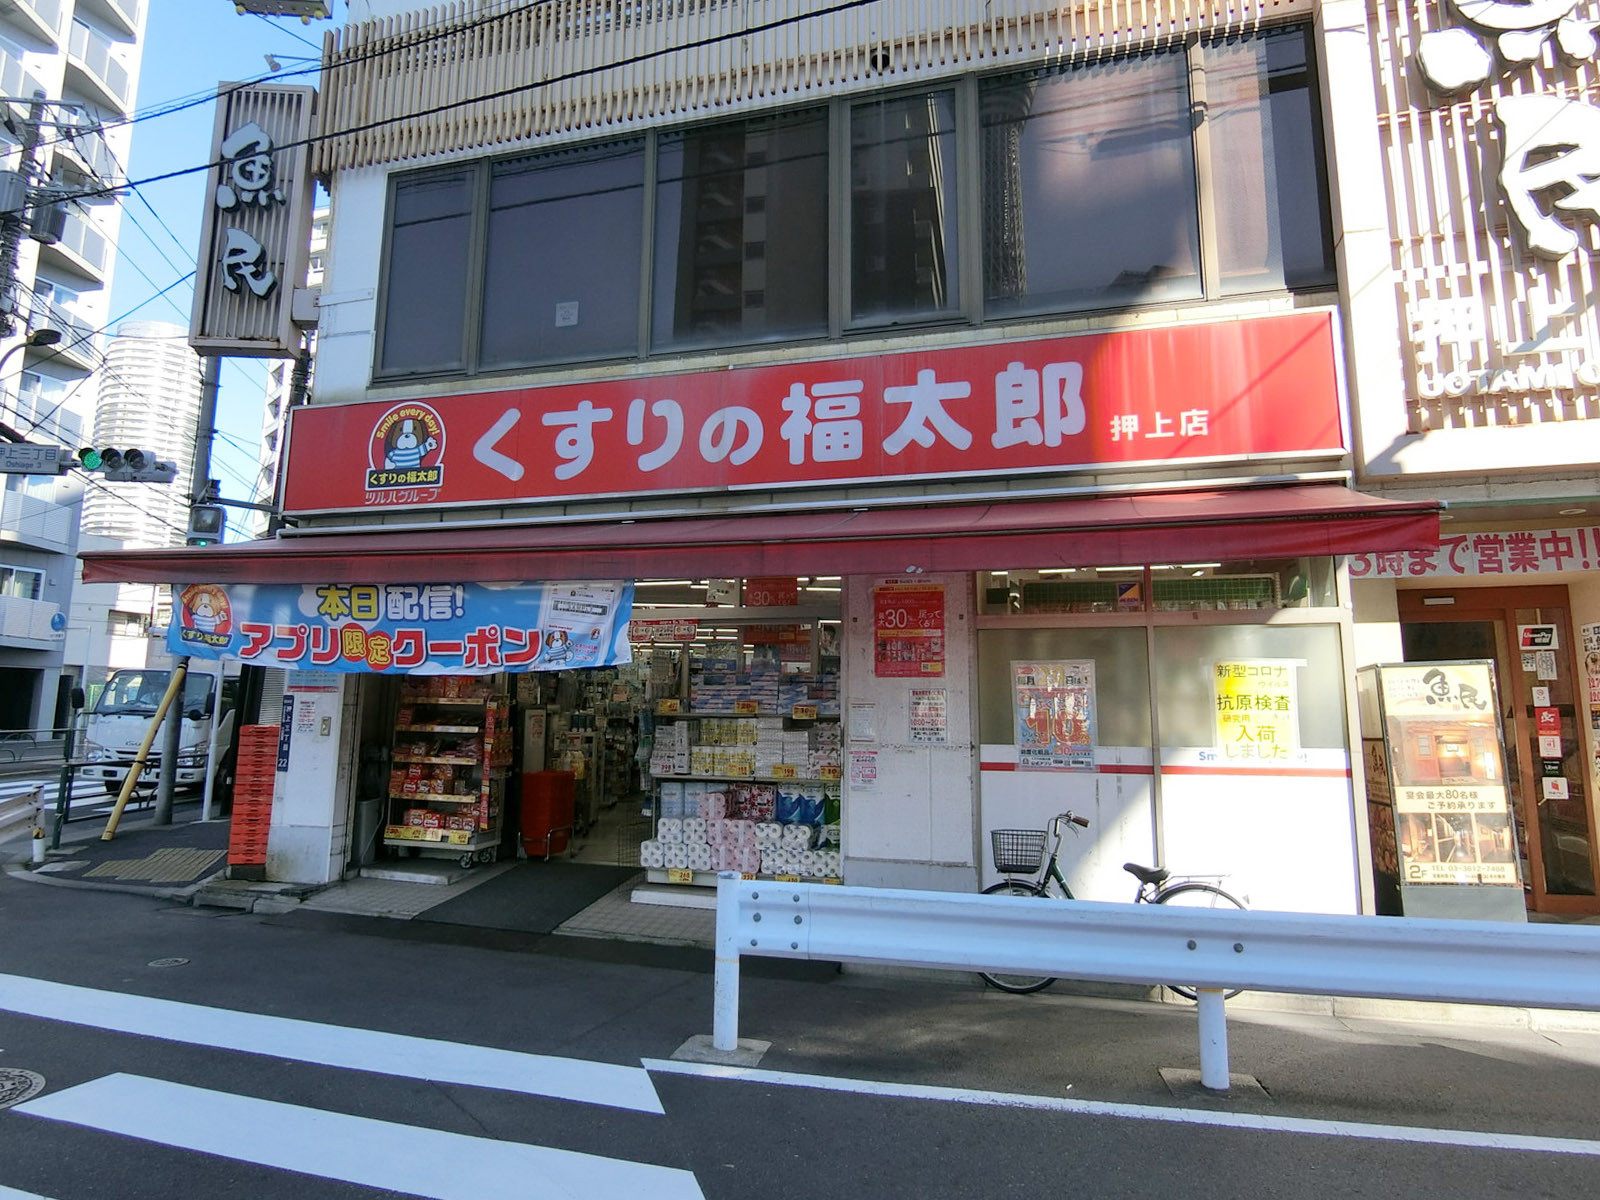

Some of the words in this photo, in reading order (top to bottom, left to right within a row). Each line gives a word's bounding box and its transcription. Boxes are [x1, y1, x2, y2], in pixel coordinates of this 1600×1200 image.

[376, 413, 399, 439] Smile
[400, 408, 425, 421] every
[424, 413, 441, 436] day!
[472, 361, 1087, 482] くすりの福太郎
[1110, 408, 1210, 442] 押上店
[369, 470, 438, 485] くすりの福太郎
[364, 488, 442, 505] ツルハグループ
[316, 584, 465, 621] 本日配信!
[885, 608, 908, 628] 30
[239, 622, 543, 668] アプリ限定クーポン
[1216, 664, 1287, 678] 新型コロナ
[1422, 668, 1487, 710] 魚民
[1216, 694, 1290, 711] 抗原検査
[1235, 725, 1276, 743] 入荷
[1225, 743, 1289, 760] しました
[1427, 801, 1496, 810] ご予約承ります
